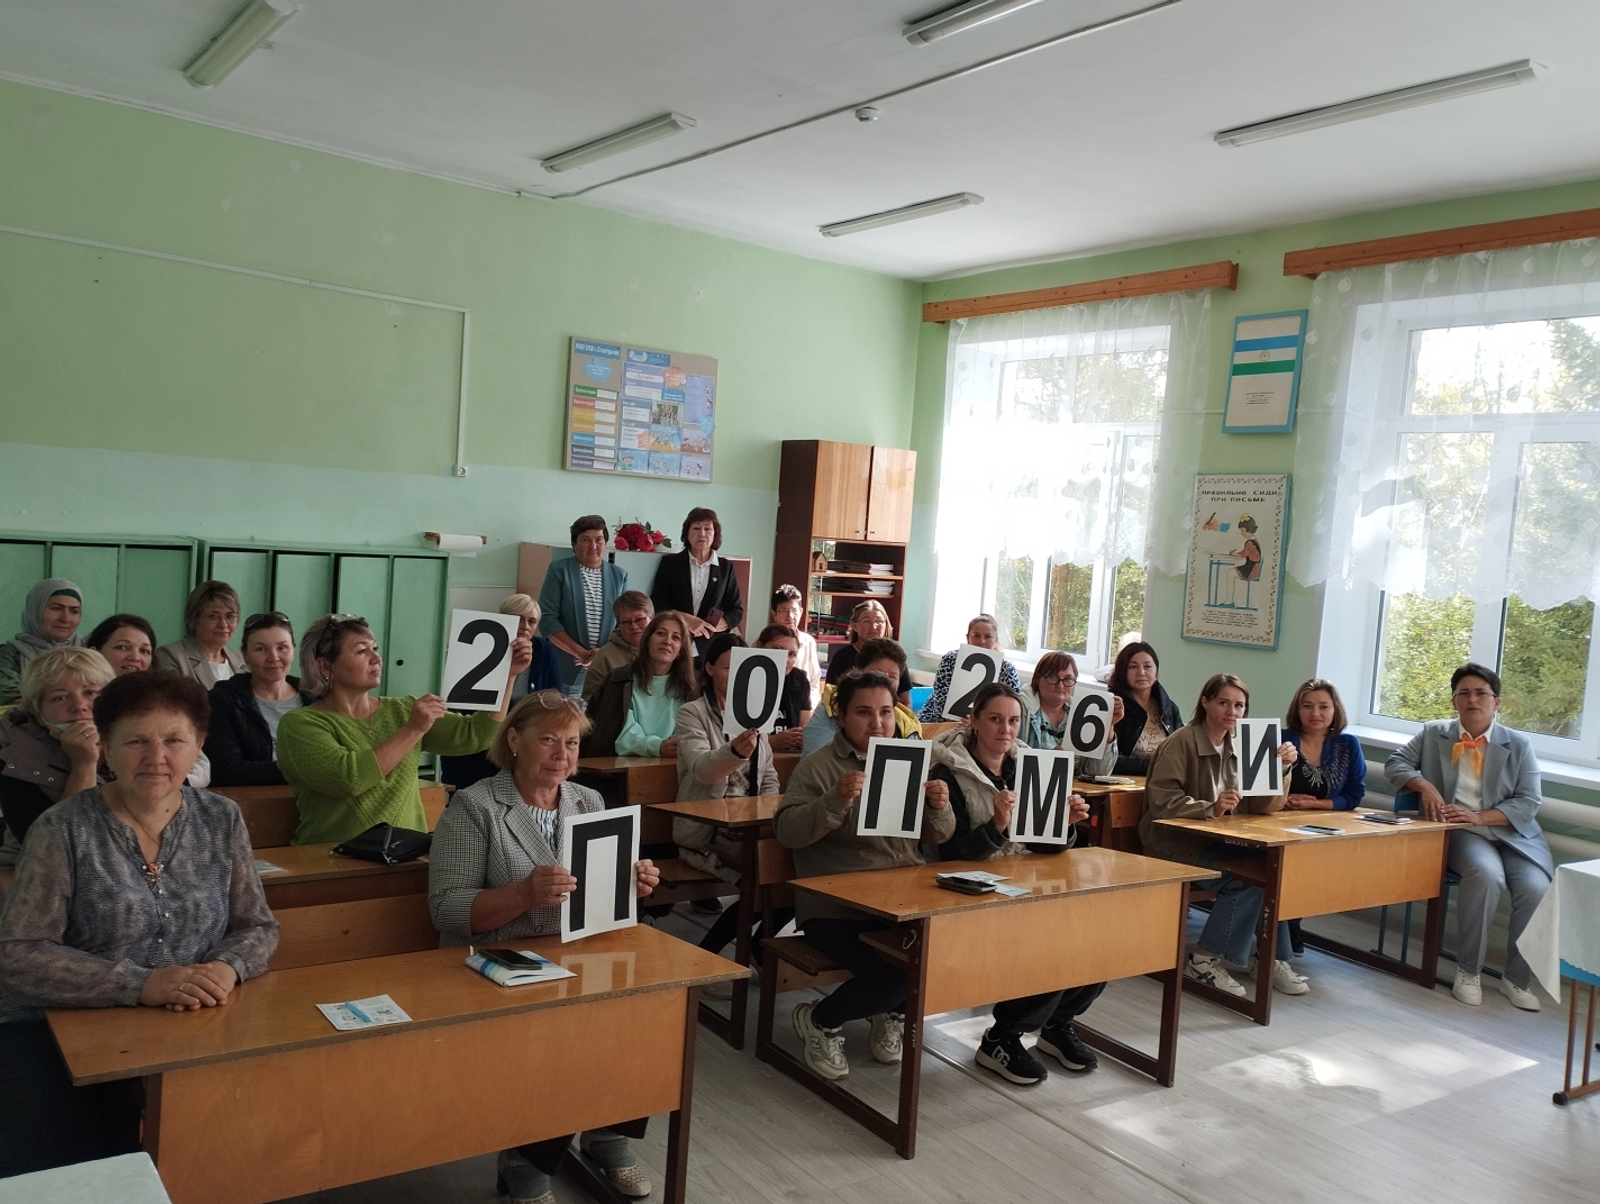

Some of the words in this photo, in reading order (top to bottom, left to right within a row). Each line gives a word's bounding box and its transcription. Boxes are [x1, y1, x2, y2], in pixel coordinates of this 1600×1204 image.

[446, 618, 511, 705] 2
[948, 653, 996, 716] 2
[1070, 694, 1108, 752] 6
[1241, 724, 1279, 791] И
[864, 744, 926, 833] П
[1015, 755, 1069, 838] М
[569, 815, 633, 932] П
[991, 1044, 1011, 1068] DG
